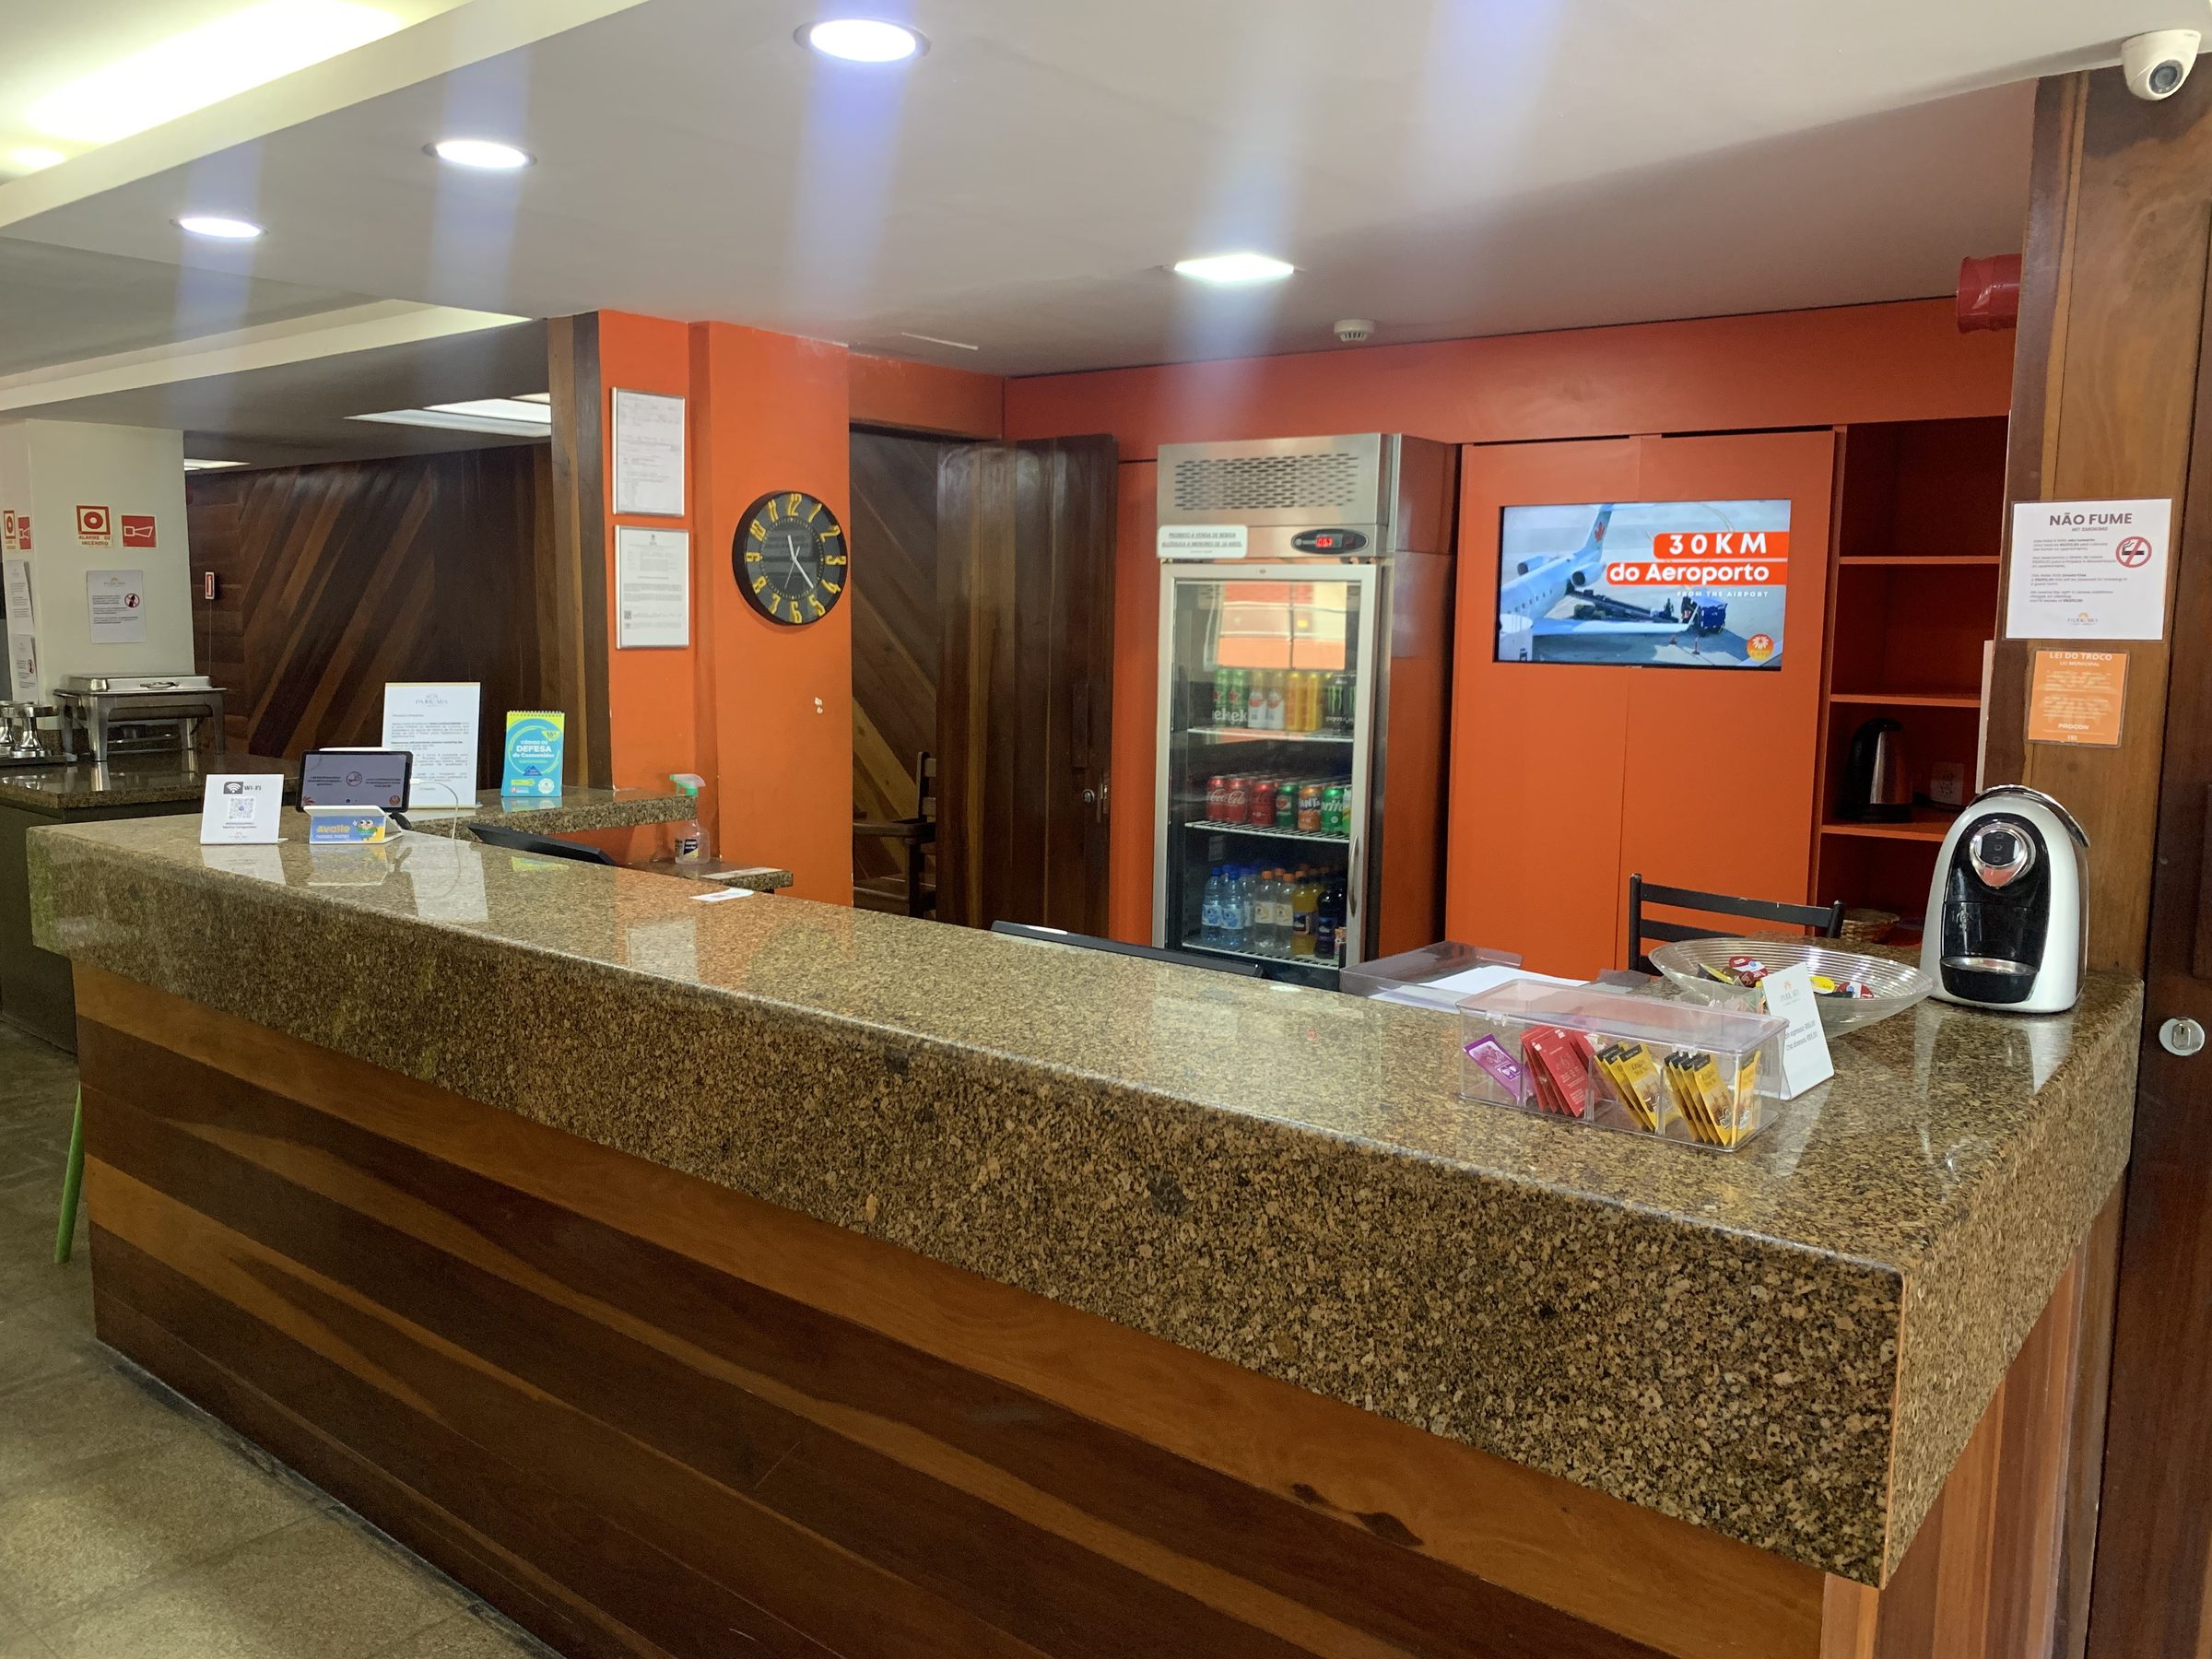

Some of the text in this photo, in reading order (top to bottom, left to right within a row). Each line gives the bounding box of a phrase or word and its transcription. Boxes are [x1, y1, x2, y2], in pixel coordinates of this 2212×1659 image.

[788, 493, 802, 516] 12
[808, 503, 822, 523] 1
[2049, 512, 2133, 526] NÃO FUME
[819, 524, 841, 542] 2
[826, 555, 846, 565] 3
[1609, 563, 1770, 586] do Aeroporto
[821, 579, 841, 594] 4
[769, 593, 782, 615] 7
[791, 600, 802, 623] 6
[808, 594, 826, 617] 5
[2080, 653, 2112, 661] TROCO
